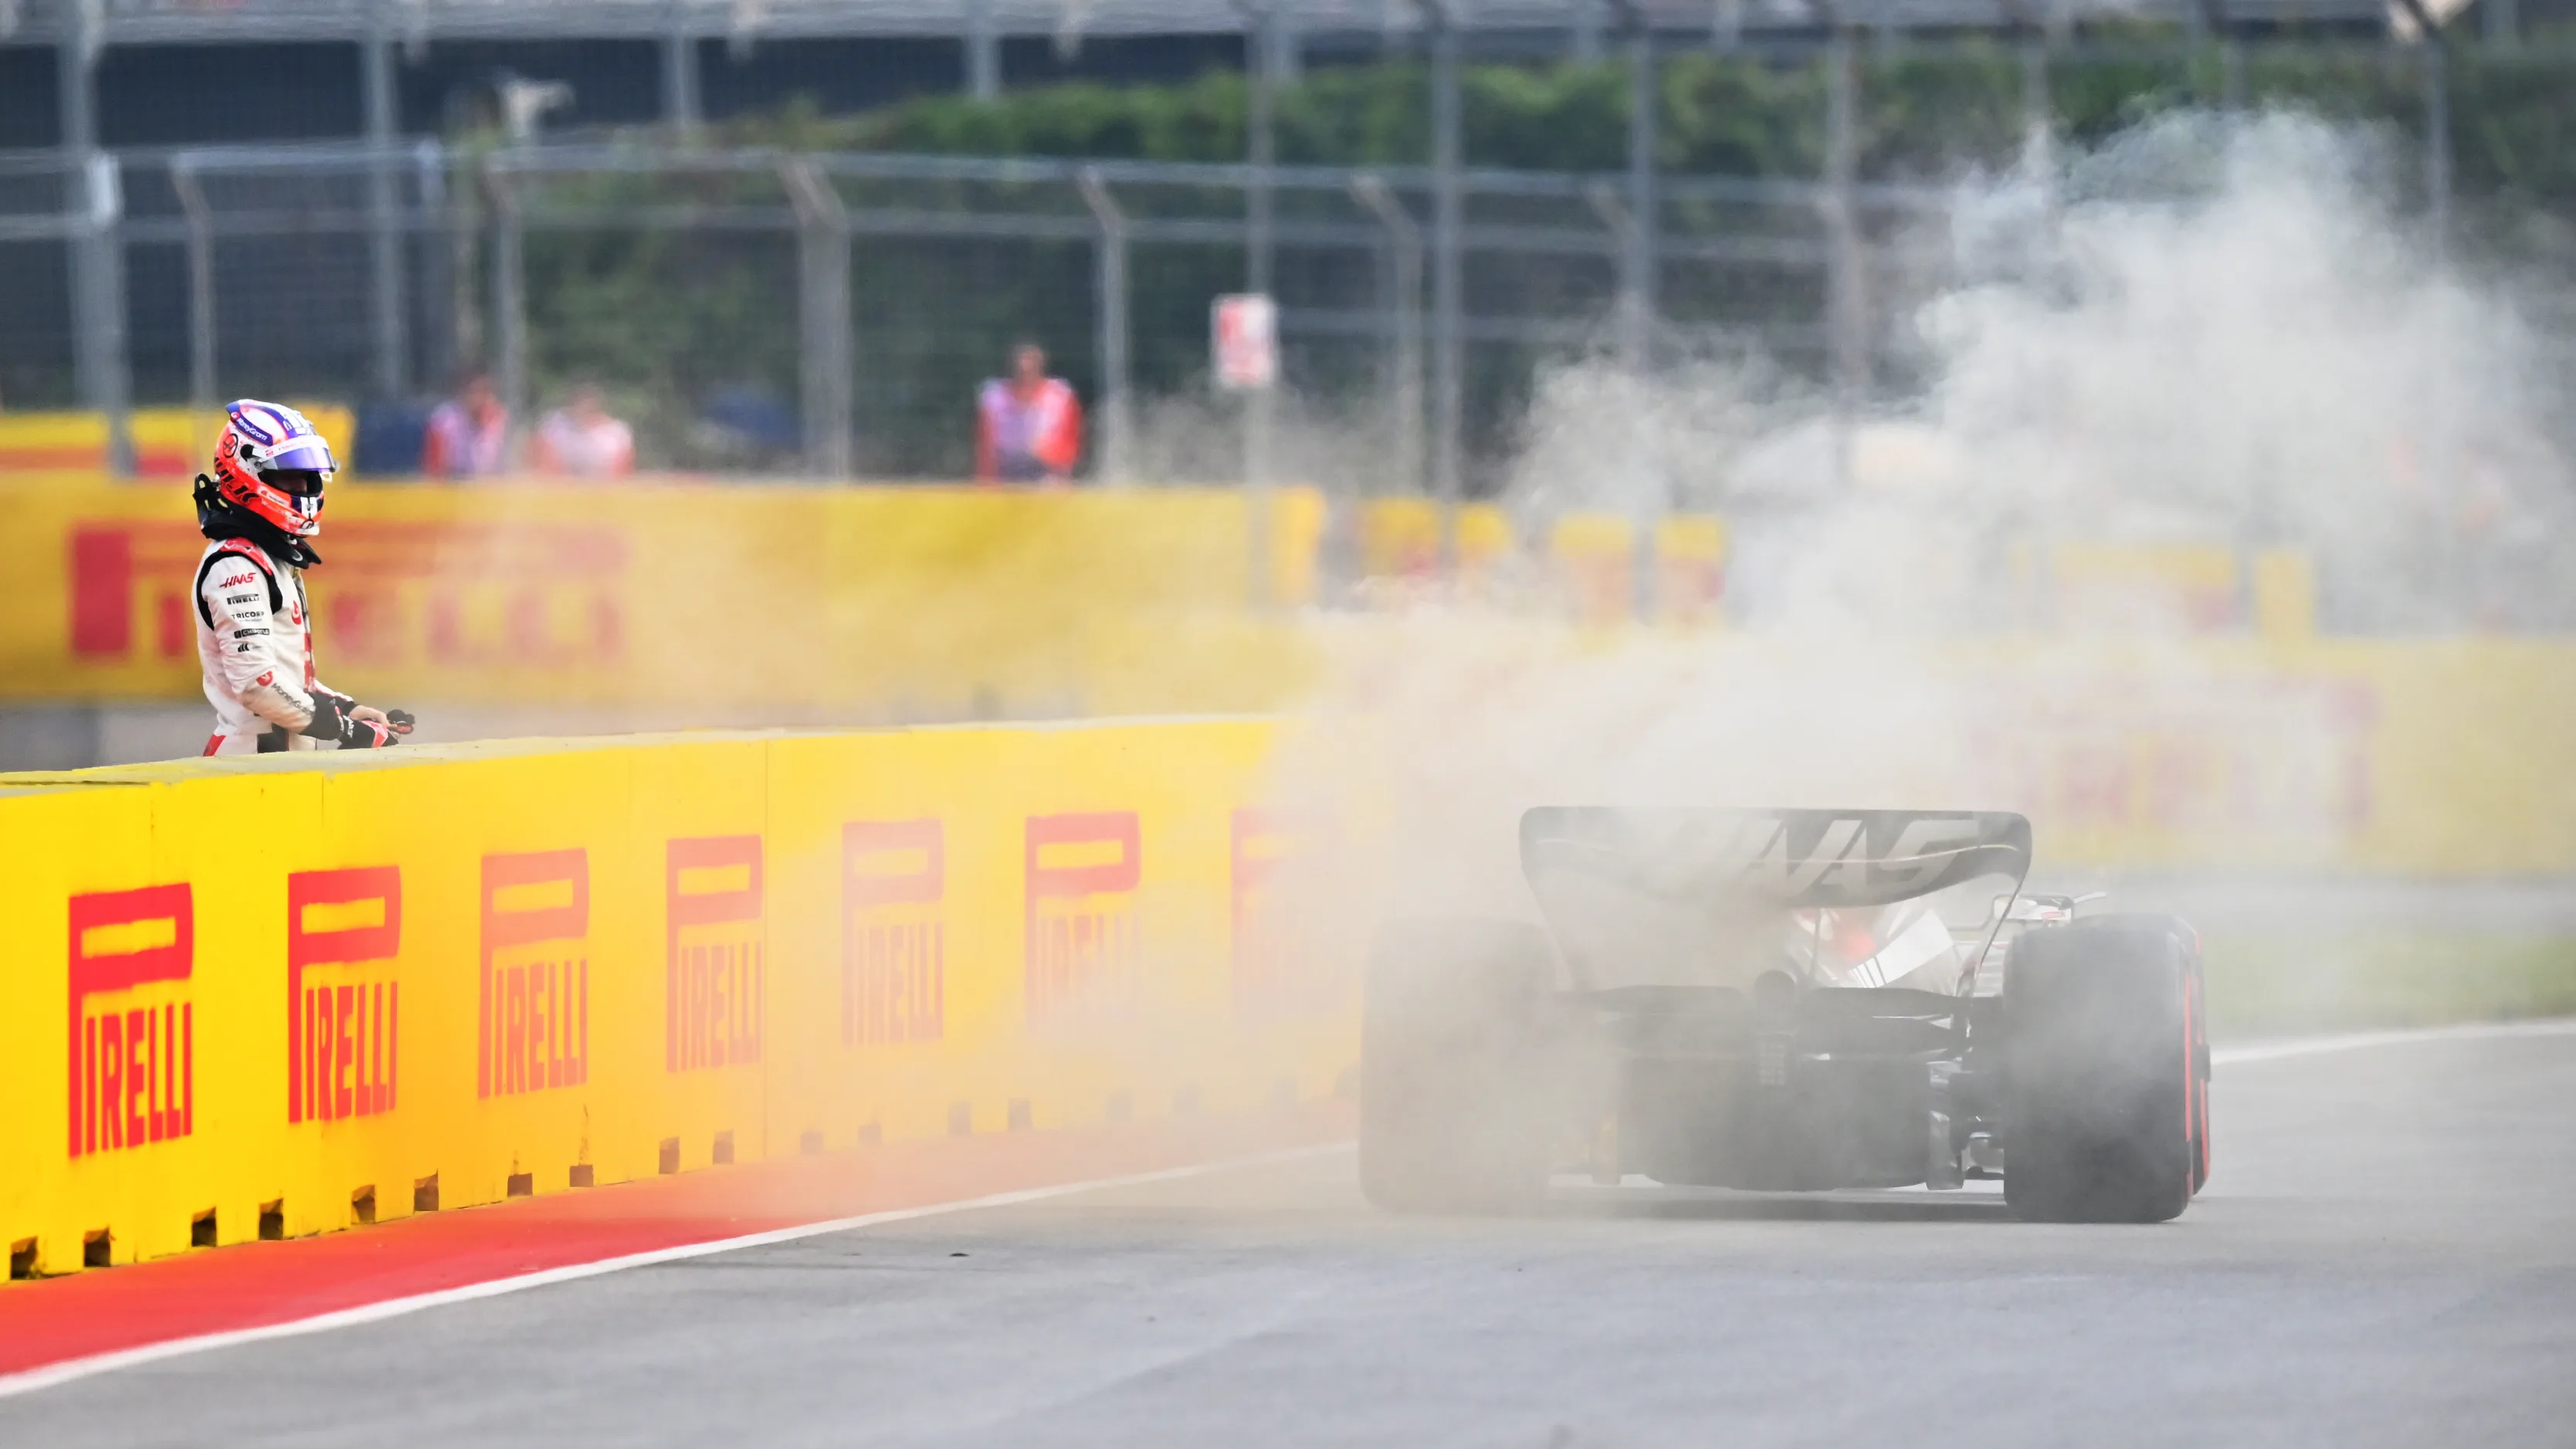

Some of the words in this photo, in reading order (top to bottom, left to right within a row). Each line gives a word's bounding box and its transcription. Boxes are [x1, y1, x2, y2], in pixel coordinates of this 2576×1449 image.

[219, 573, 256, 587] HAAS
[68, 882, 193, 1161] PIRELLI
[287, 865, 401, 1124] PIRELLI
[478, 848, 589, 1101] PIRELLI
[666, 835, 763, 1073] PIRELLI
[842, 818, 944, 1048] PIRELLI
